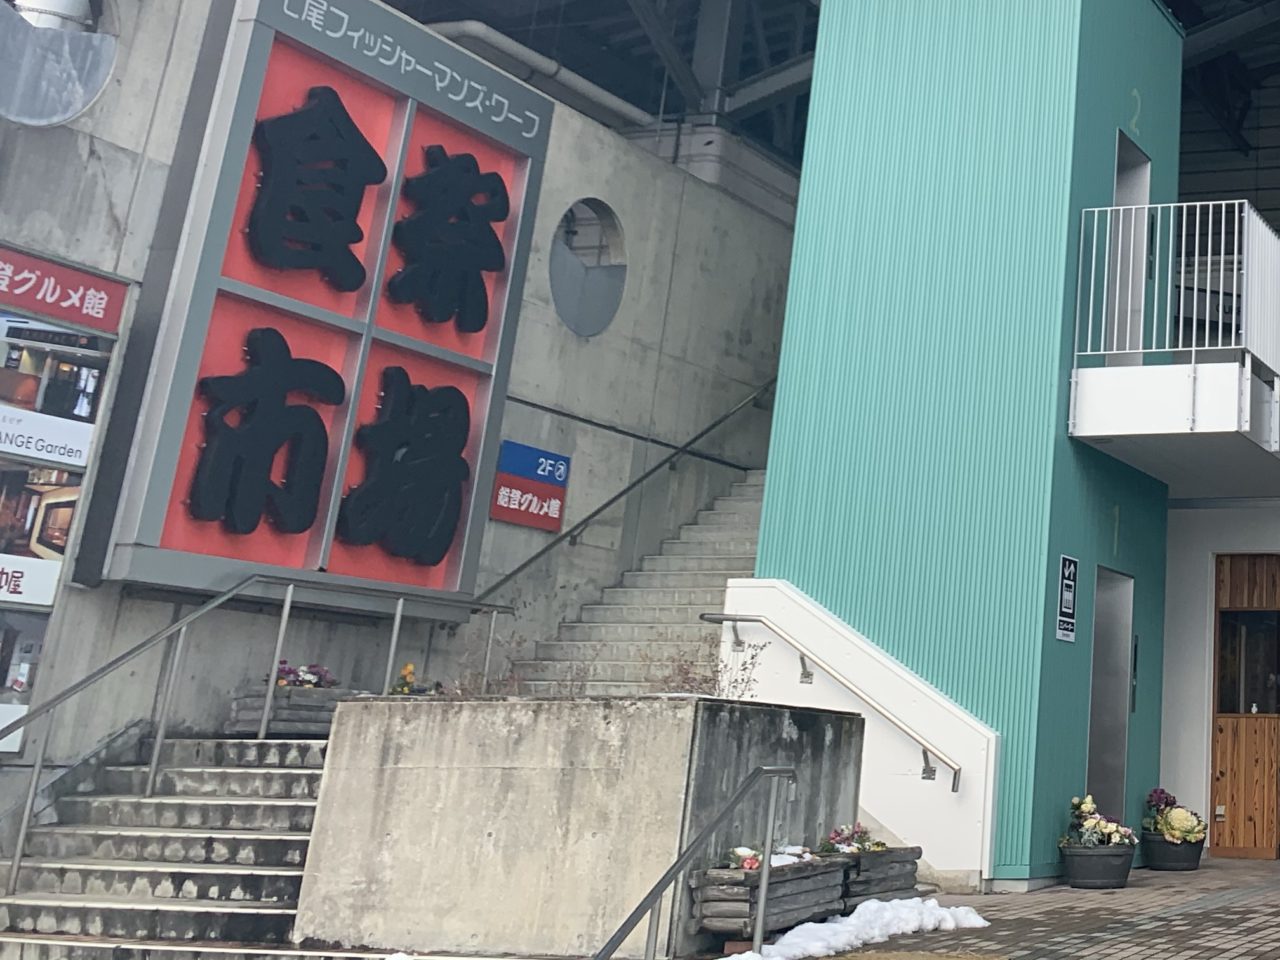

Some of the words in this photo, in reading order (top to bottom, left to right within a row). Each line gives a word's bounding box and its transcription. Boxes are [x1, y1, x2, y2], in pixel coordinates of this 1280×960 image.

[35, 438, 83, 459] Garden
[537, 457, 555, 476] 2F
[496, 486, 562, 519] 能登グルメ館
